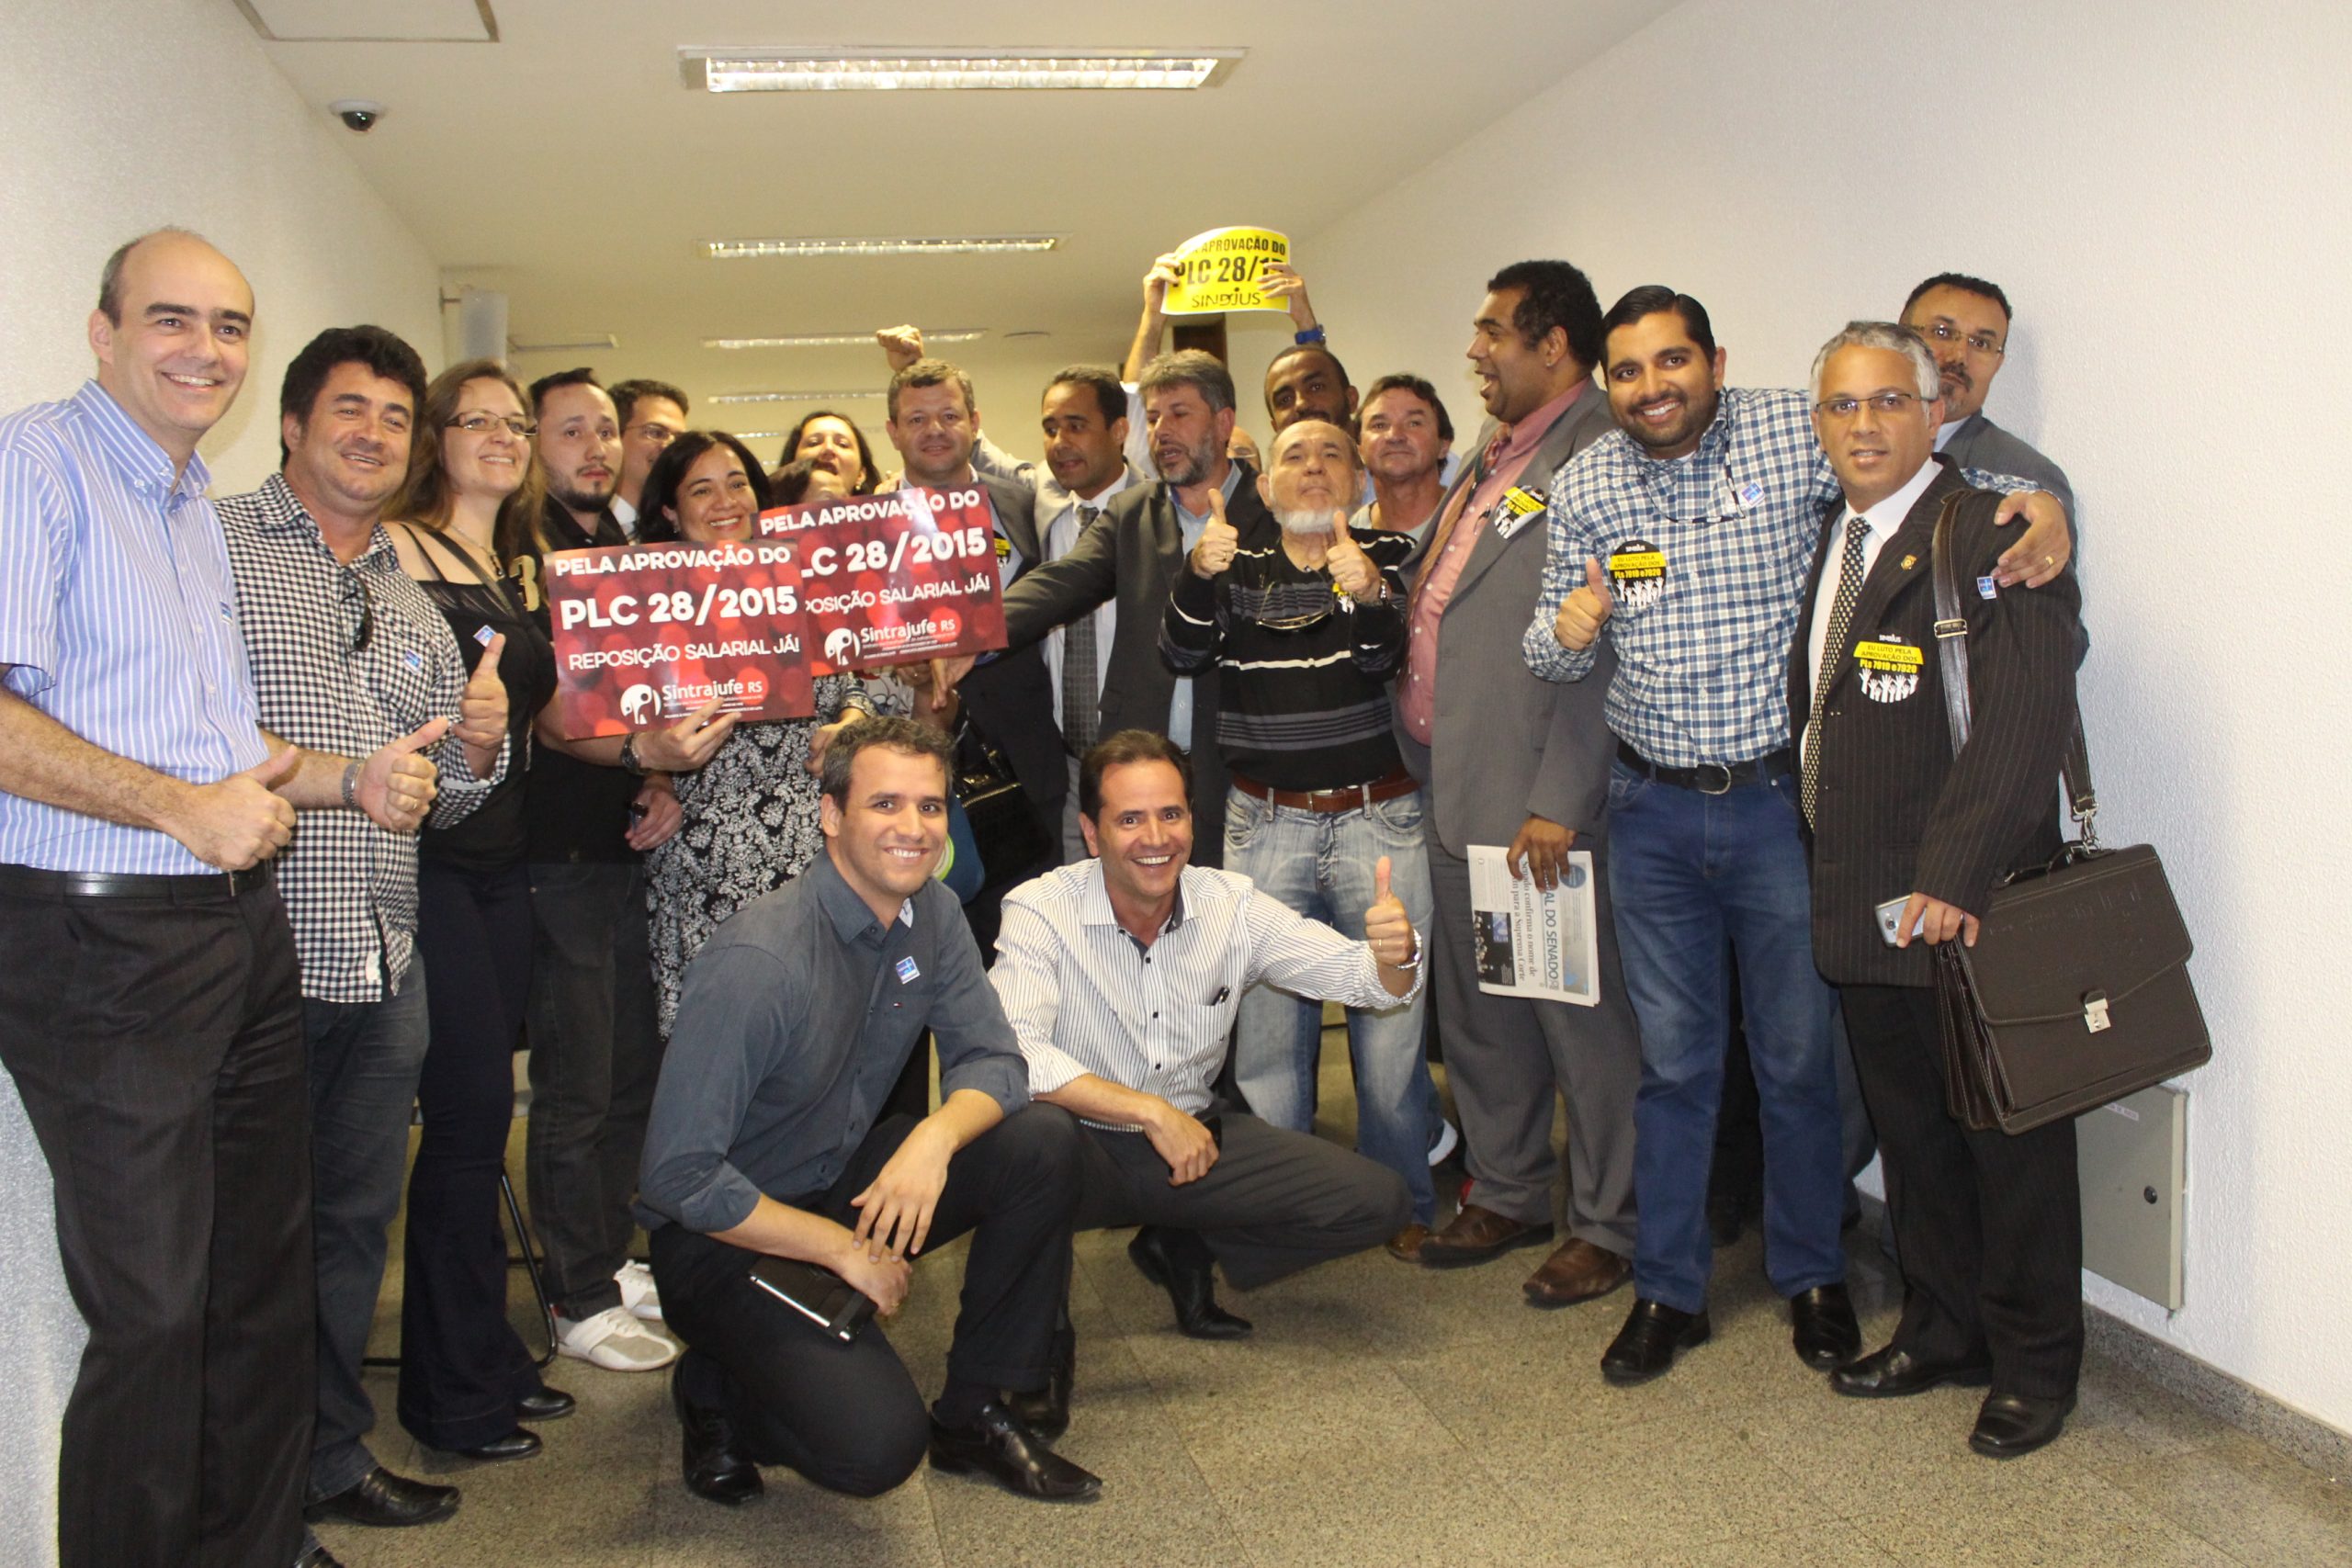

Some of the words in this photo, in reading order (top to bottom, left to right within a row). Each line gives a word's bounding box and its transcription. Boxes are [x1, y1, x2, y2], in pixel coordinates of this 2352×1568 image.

[1272, 241, 1285, 256] DO
[760, 511, 816, 536] PELA
[949, 490, 980, 509] DO
[555, 556, 616, 576] PELA
[618, 544, 754, 572] APROVAÇÃO
[759, 547, 790, 564] DO
[846, 527, 987, 573] 28/2015
[560, 595, 639, 630] PLC
[648, 583, 797, 626] 28/2015
[805, 590, 876, 615] OSIÇÃO
[879, 581, 962, 604] SALARIAL
[965, 572, 990, 593] JÁ!
[860, 618, 937, 644] Sintrajufe
[940, 619, 956, 632] RS
[569, 643, 680, 670] REPOSIÇÃO
[684, 638, 771, 660] SALARIAL
[774, 634, 800, 654] JÁ!
[662, 679, 743, 700] Sintrajufe
[747, 681, 763, 694] RS
[1510, 890, 1520, 910] para
[1545, 909, 1556, 927] DO
[1513, 919, 1523, 956] Suprema
[1524, 892, 1534, 932] confirma
[1529, 966, 1538, 977] de
[1546, 931, 1559, 979] SENADO
